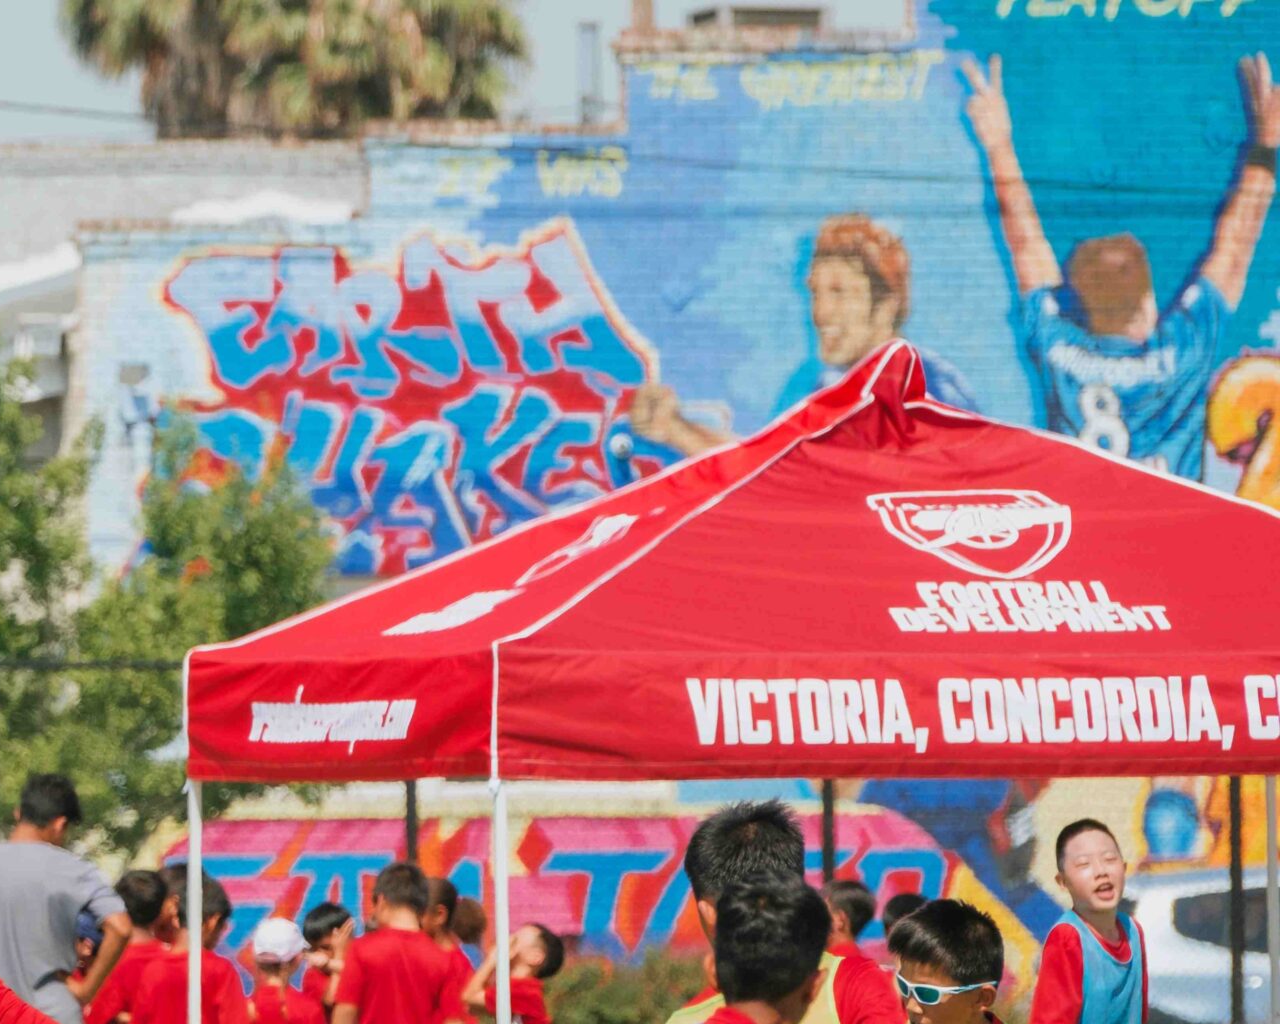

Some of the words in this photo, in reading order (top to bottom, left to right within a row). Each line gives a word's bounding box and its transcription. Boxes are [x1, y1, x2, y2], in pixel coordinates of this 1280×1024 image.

[160, 216, 658, 400] EARTH
[1079, 383, 1131, 458] 8
[888, 604, 1172, 633] DEVELOPMENT
[915, 580, 1120, 609] FOOTBALL
[685, 676, 930, 754] VICTORIA,
[937, 674, 1236, 752] CONCORDIA,
[1242, 673, 1280, 740] C
